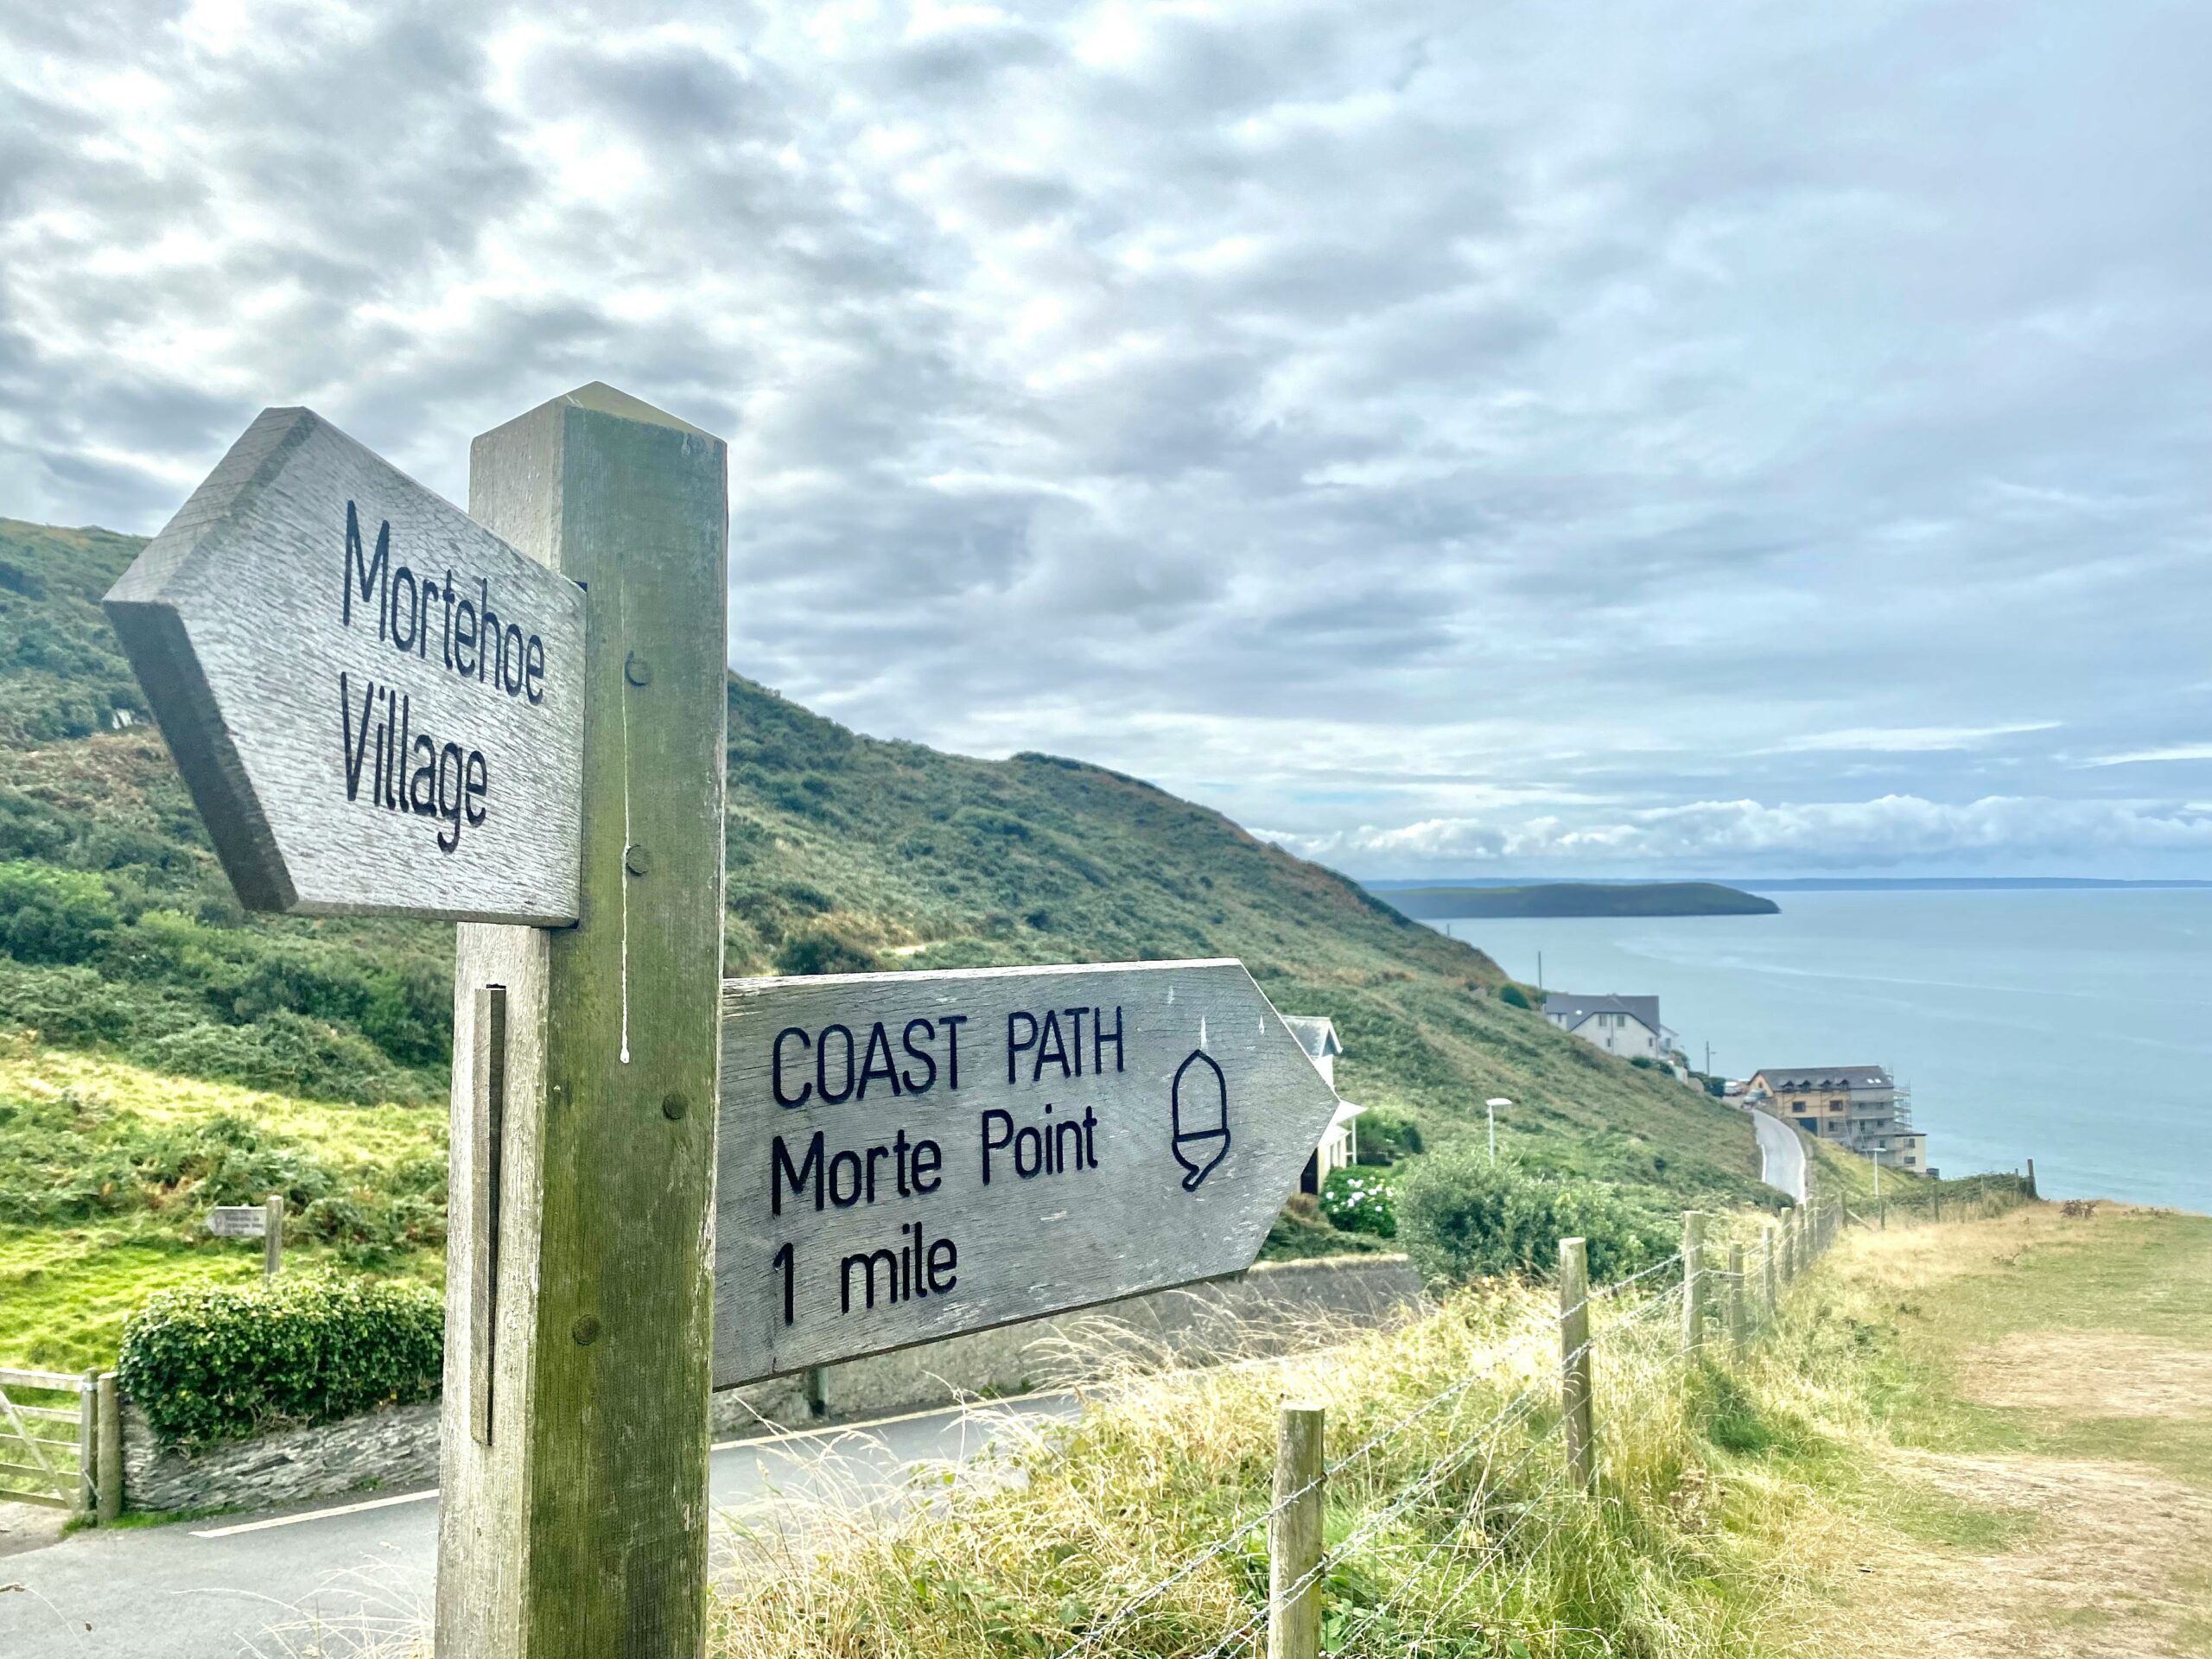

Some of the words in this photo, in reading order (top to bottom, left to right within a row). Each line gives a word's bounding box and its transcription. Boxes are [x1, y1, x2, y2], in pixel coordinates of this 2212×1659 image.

[343, 500, 544, 705] Mortehoe
[340, 671, 488, 854] Village
[773, 1015, 968, 1109] COAST
[1007, 1006, 1124, 1084] PATH
[772, 1129, 943, 1216] Morte
[982, 1104, 1098, 1185] Point
[774, 1243, 795, 1325] 1
[841, 1222, 958, 1314] mile
